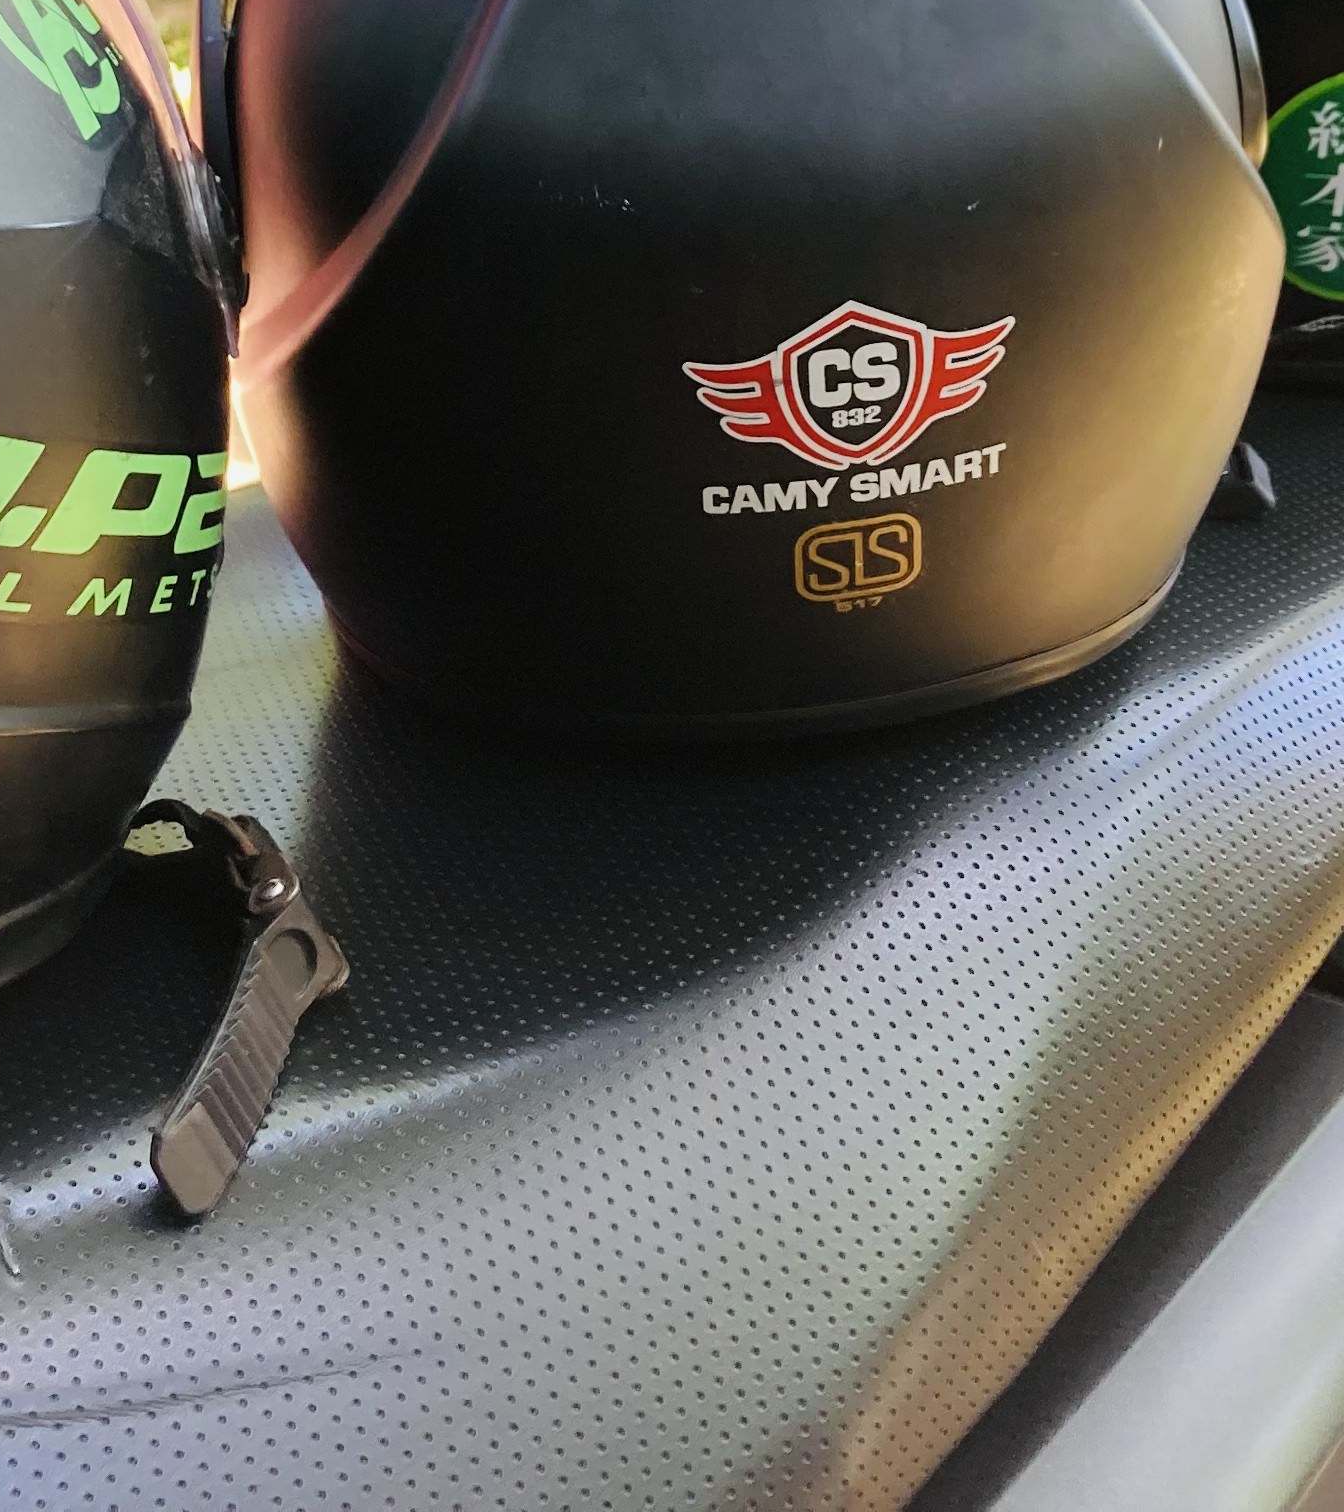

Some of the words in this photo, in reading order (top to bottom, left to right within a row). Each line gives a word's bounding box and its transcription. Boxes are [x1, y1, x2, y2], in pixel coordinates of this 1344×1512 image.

[807, 341, 902, 408] CS
[832, 405, 882, 428] 832
[702, 476, 839, 515] CAMY
[850, 442, 1007, 502] SMART
